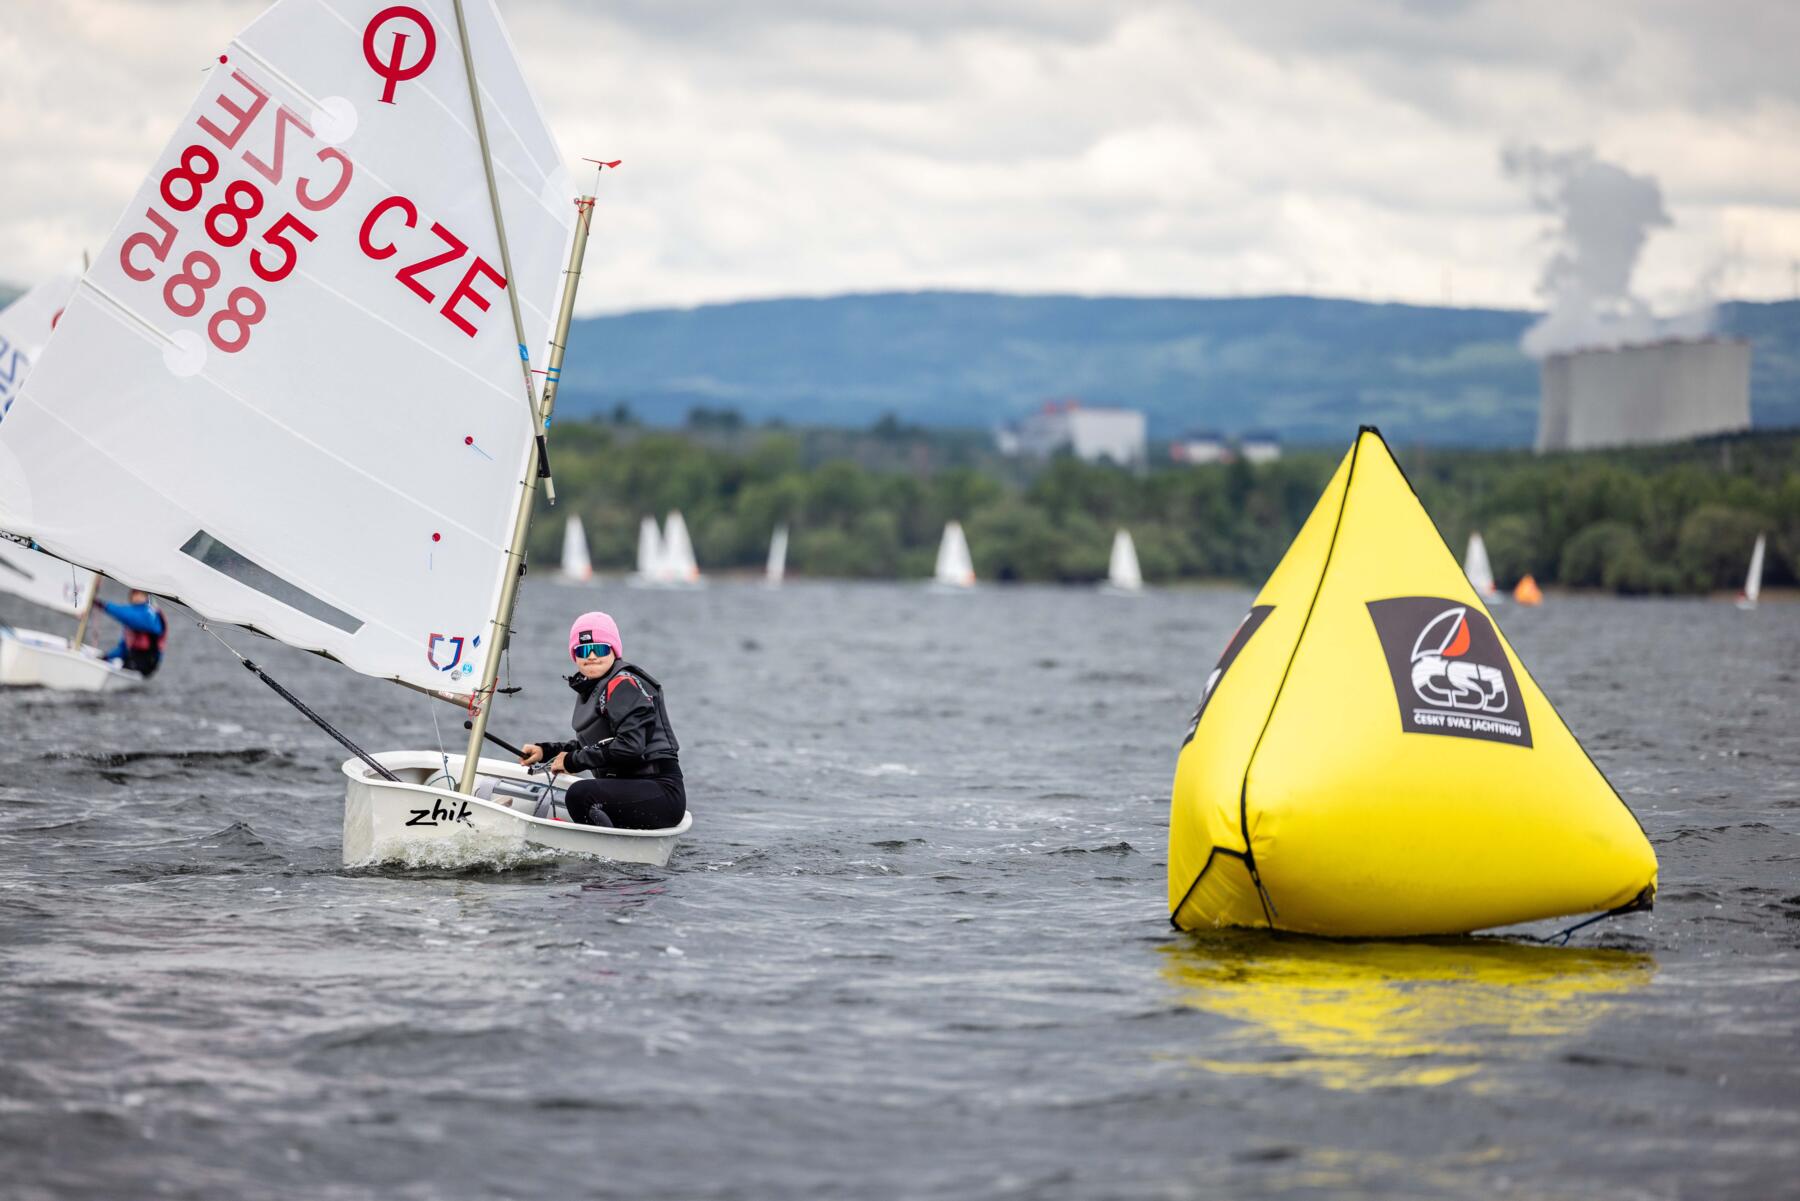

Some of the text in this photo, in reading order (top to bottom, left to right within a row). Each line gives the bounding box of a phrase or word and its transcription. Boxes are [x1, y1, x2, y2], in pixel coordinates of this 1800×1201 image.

[160, 144, 319, 283] 885
[358, 195, 508, 338] CZE
[1446, 716, 1471, 730] SVAZ
[1472, 719, 1522, 737] JACHTINGU
[405, 798, 473, 828] zhik
